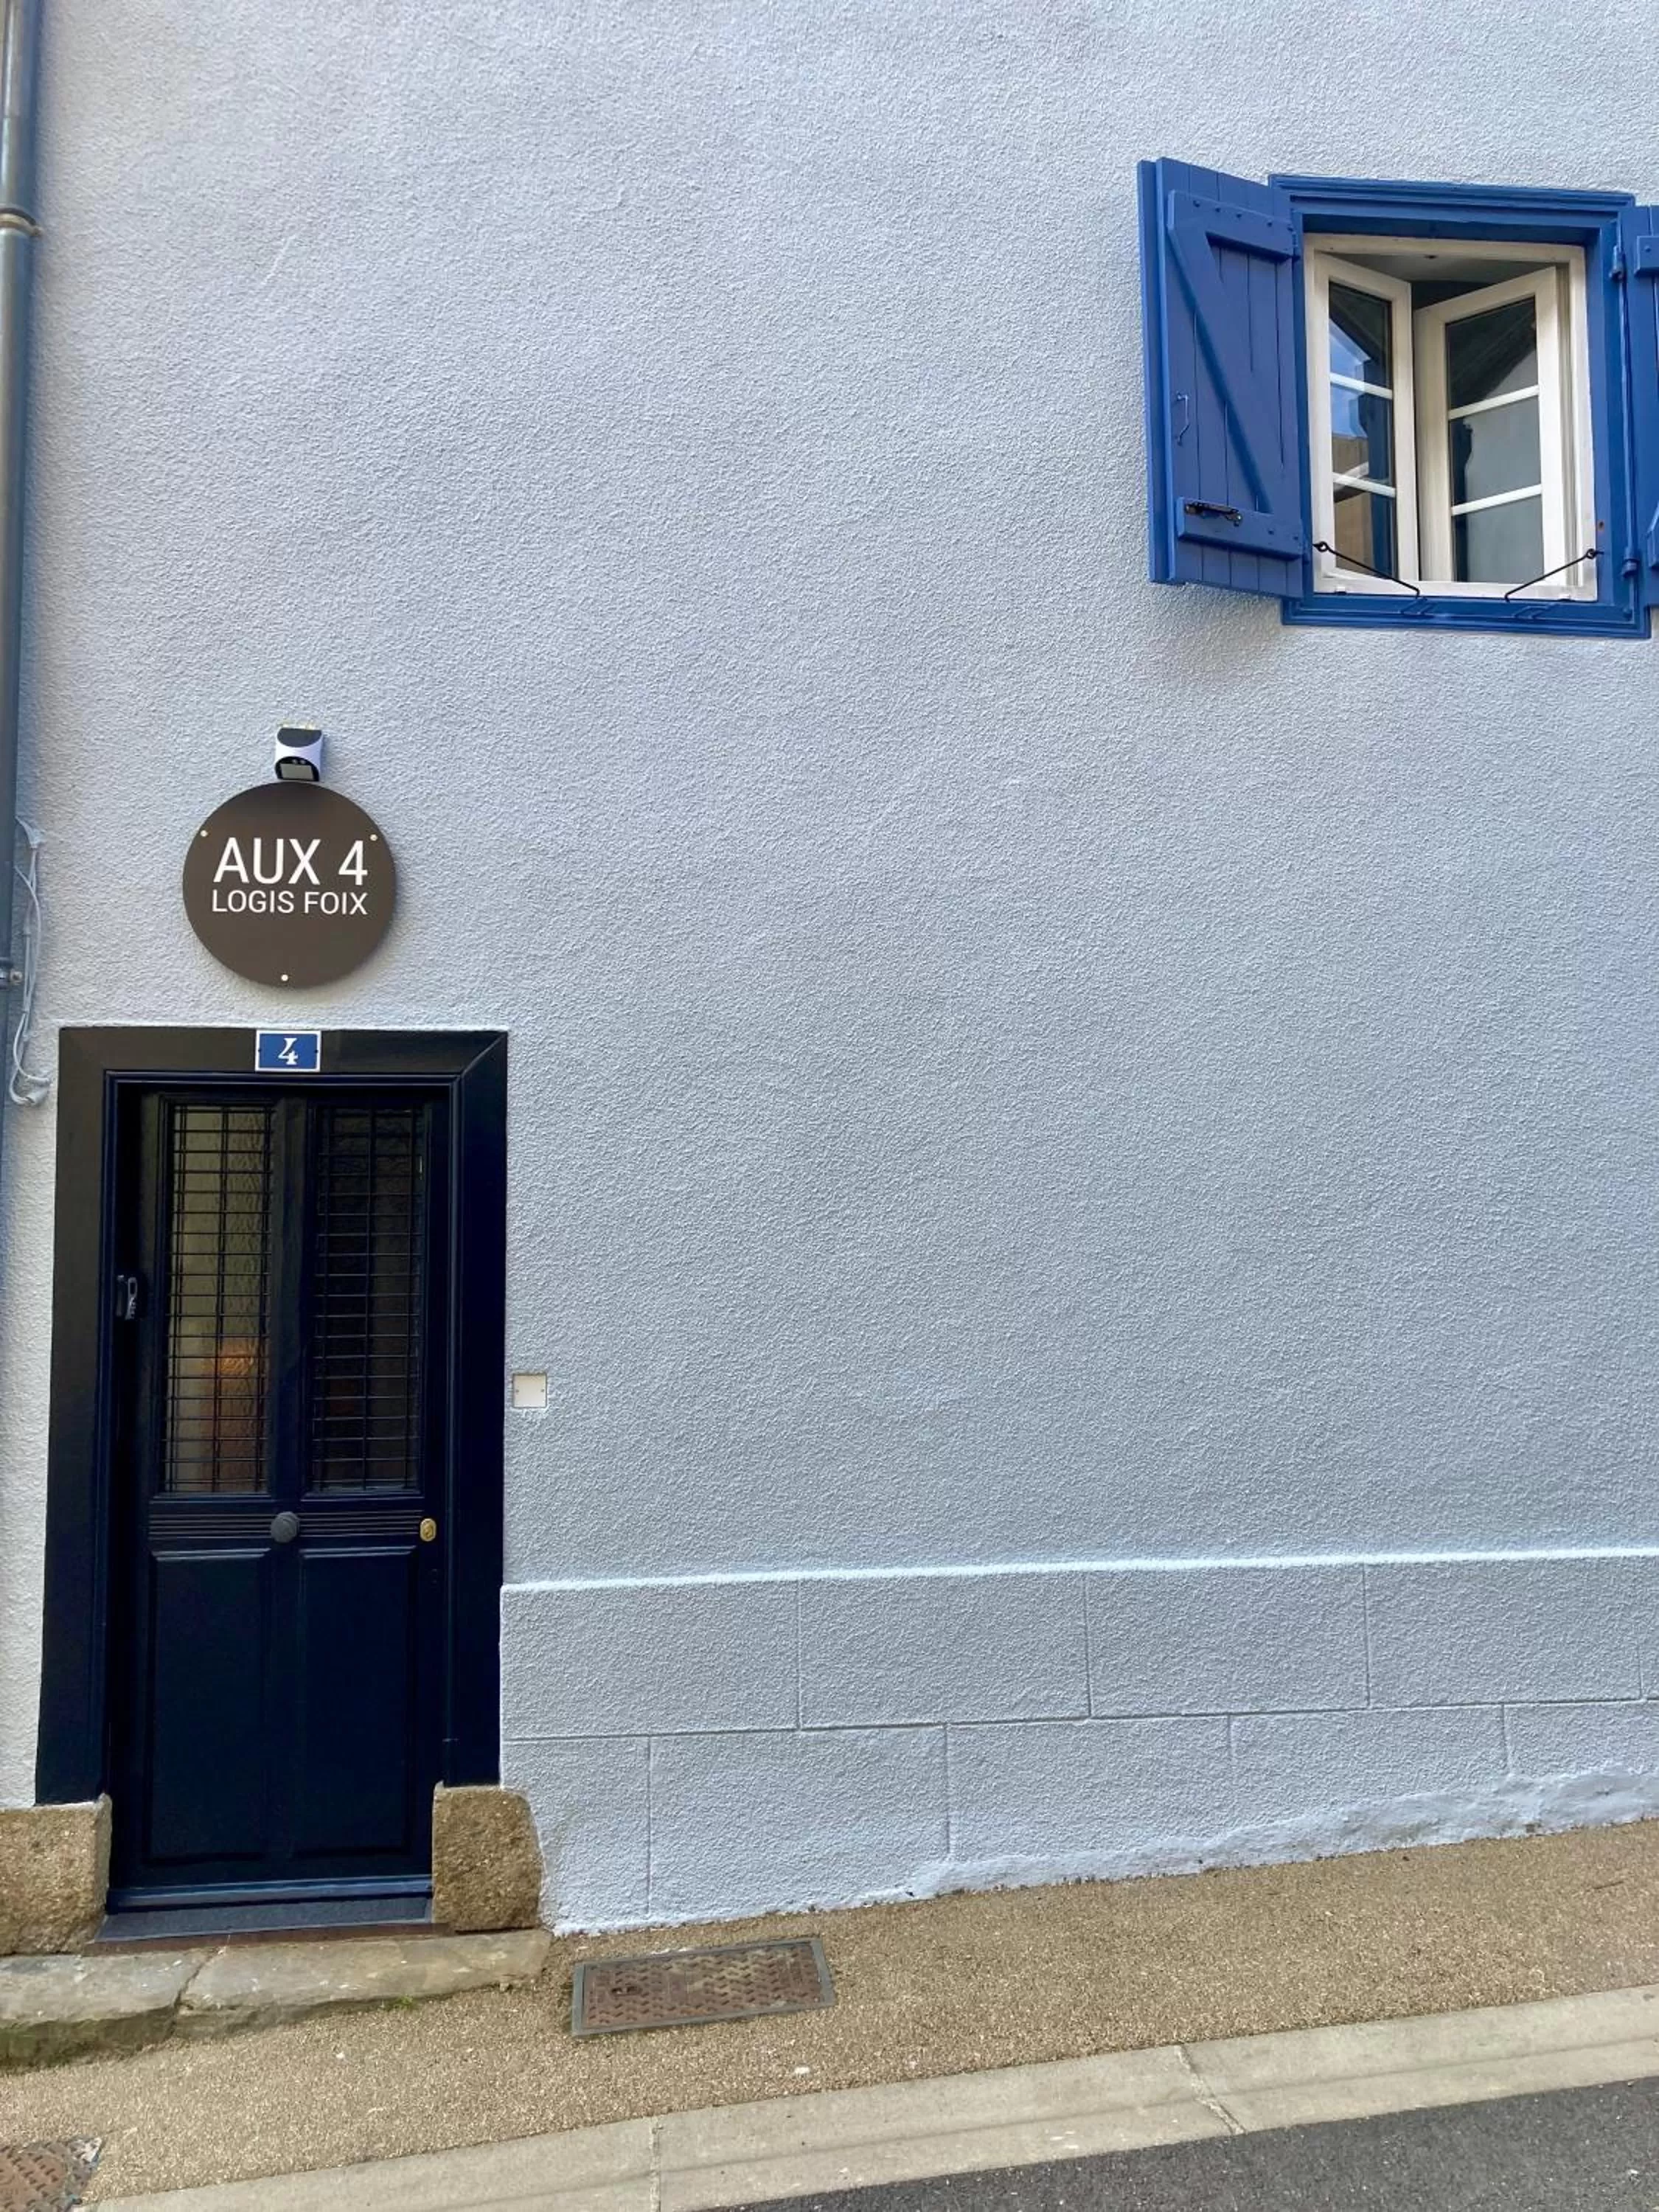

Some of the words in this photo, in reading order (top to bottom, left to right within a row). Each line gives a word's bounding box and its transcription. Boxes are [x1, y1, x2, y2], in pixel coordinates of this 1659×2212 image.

[213, 837, 321, 885] AUX
[338, 840, 368, 886] 4
[212, 889, 295, 914] LOGIS
[304, 891, 369, 915] FOIX
[277, 1037, 299, 1065] 4
